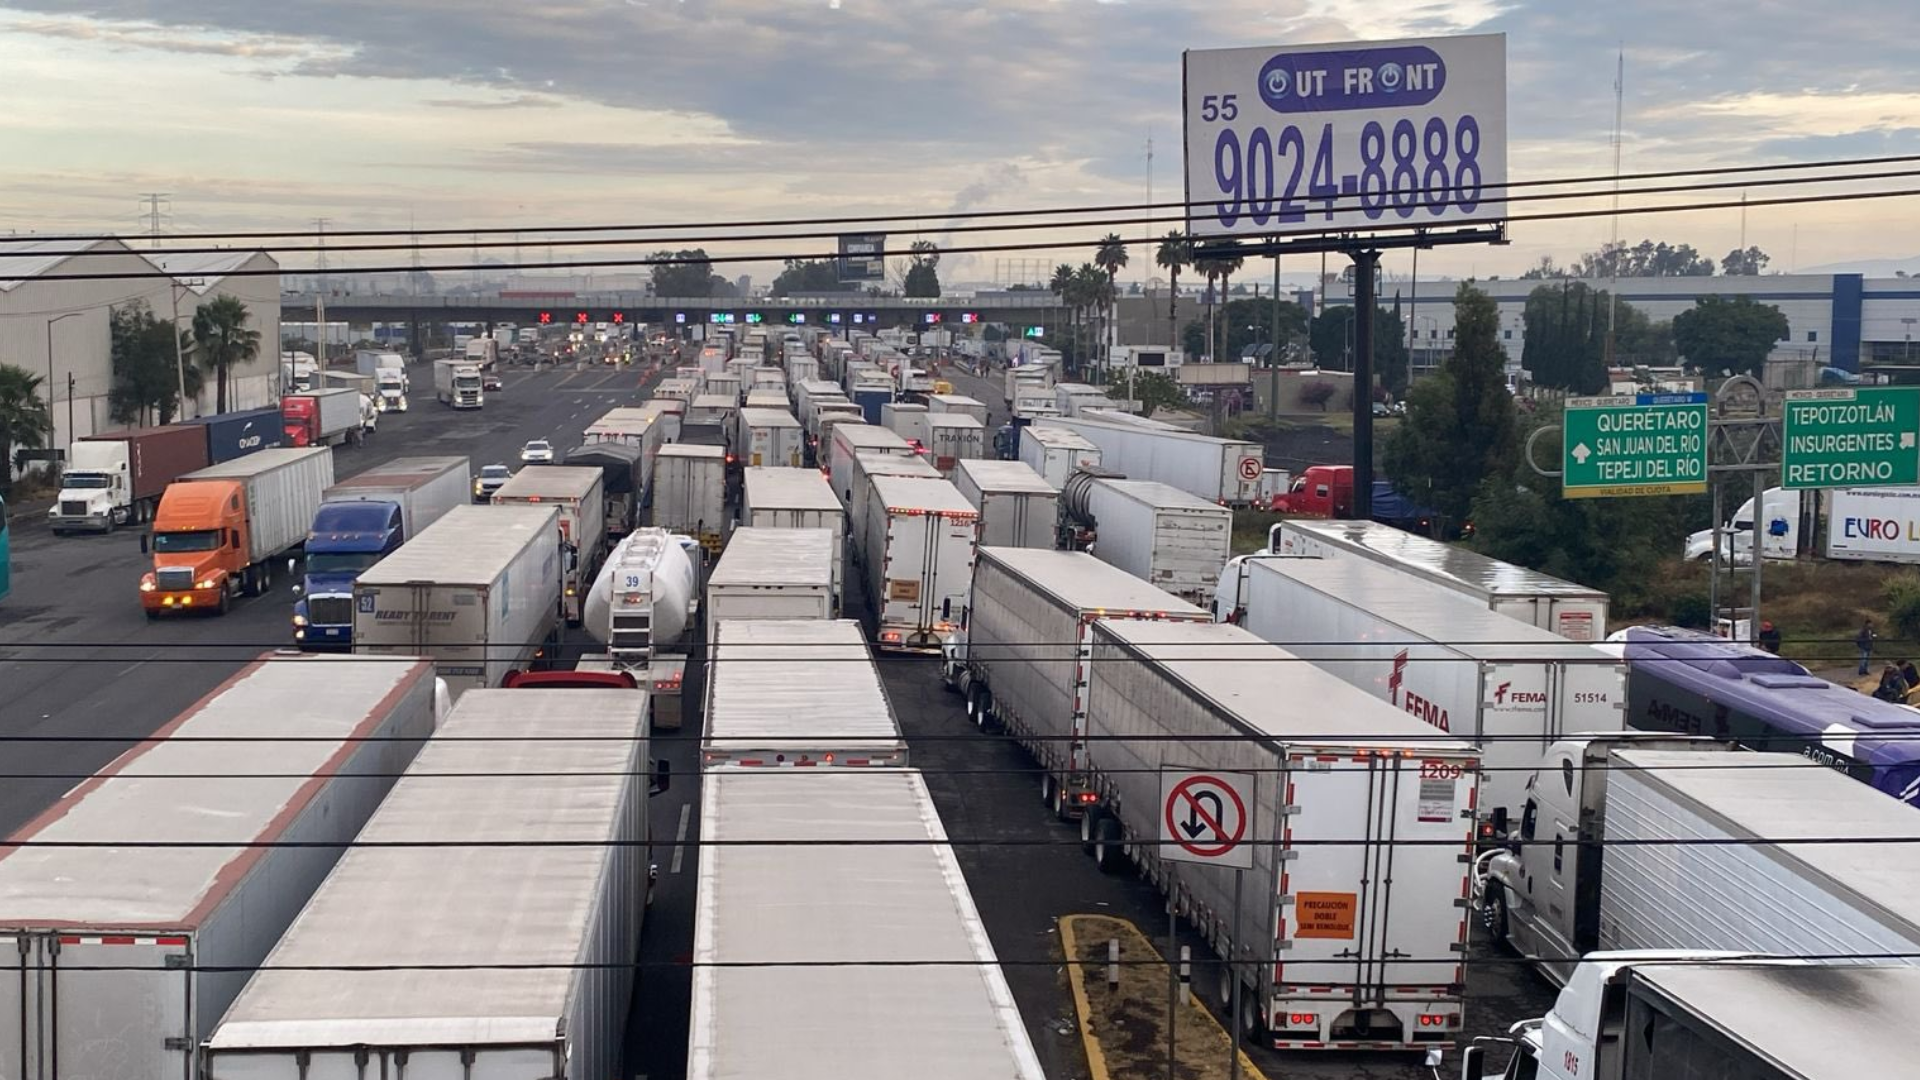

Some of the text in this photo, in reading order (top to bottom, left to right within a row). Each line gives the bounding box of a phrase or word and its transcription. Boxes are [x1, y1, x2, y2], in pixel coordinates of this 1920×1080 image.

[1201, 94, 1238, 122] 55
[1214, 115, 1482, 228] 9024-8888
[1597, 408, 1701, 432] QUERÉTARO
[1792, 400, 1895, 425] TEPOTZOTLÁN
[1597, 430, 1700, 456] SAN JUAN DEL RÍO
[1790, 433, 1895, 454] INSURGENTES
[1597, 454, 1700, 480] TEPEJI DEL RÍO
[1789, 461, 1893, 482] RETORNO
[1845, 517, 1920, 541] EURO L
[626, 576, 639, 587] 39
[375, 611, 410, 620] READY
[1511, 692, 1606, 703] FEMA 51514
[1405, 690, 1450, 733] FEMA
[1419, 764, 1460, 780] 1209
[1314, 912, 1336, 920] DOBLE
